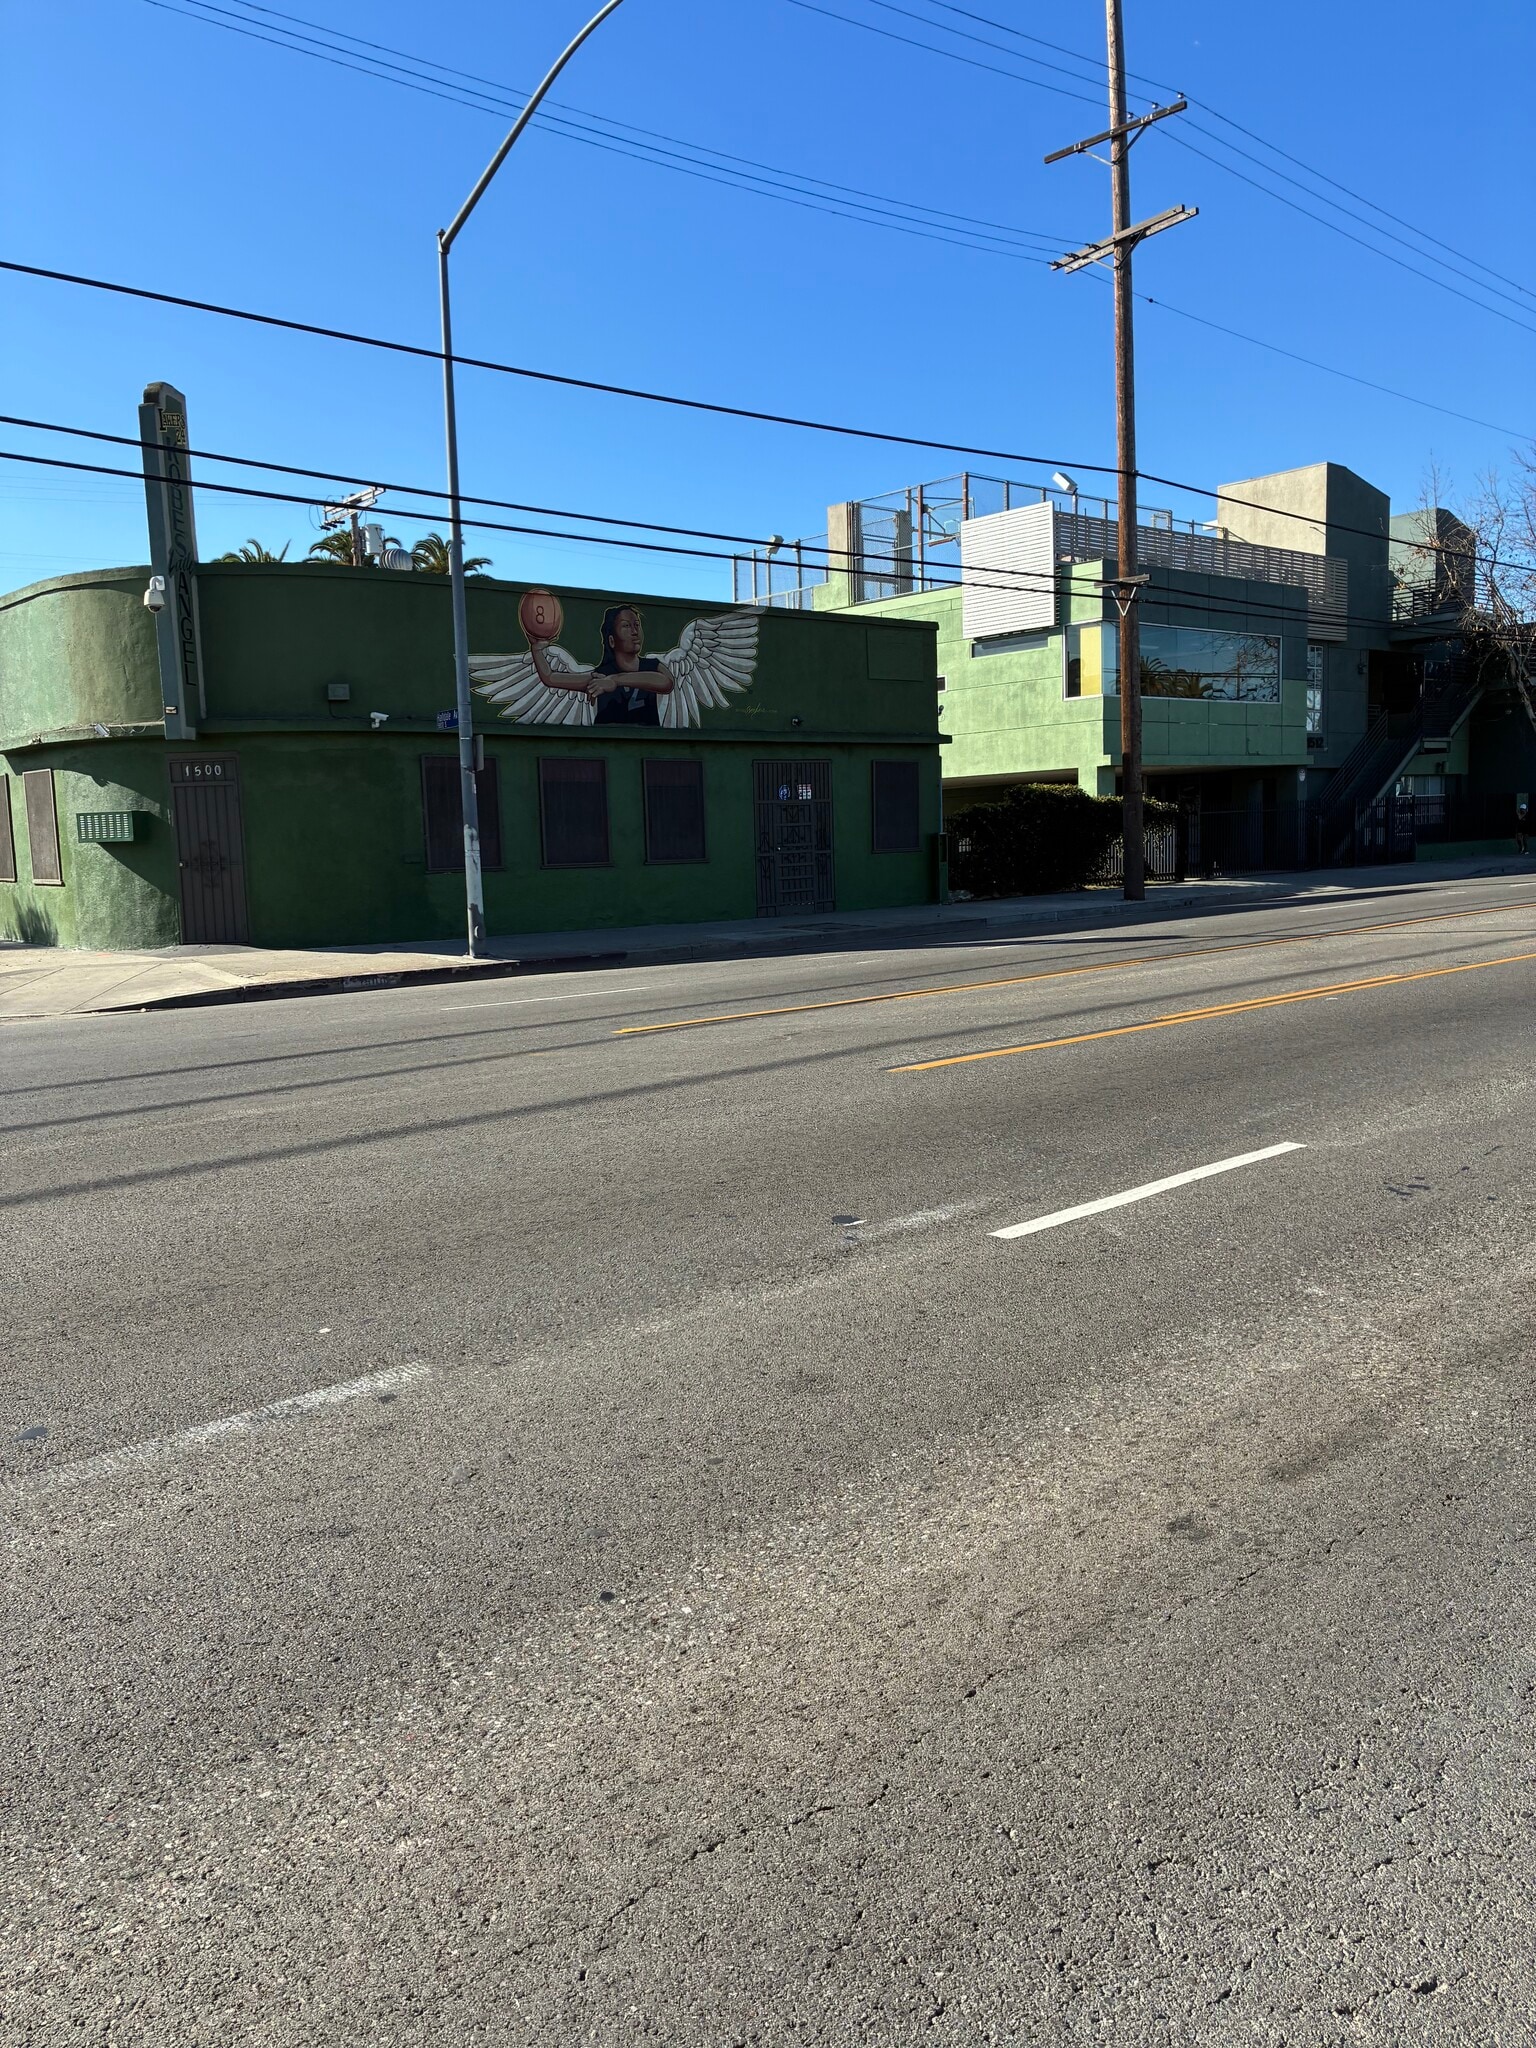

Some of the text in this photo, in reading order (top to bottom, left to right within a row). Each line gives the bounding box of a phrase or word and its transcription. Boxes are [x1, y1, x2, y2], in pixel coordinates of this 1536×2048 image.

[535, 605, 545, 625] 8
[178, 571, 197, 687] ANGEL
[185, 764, 222, 777] 1500
